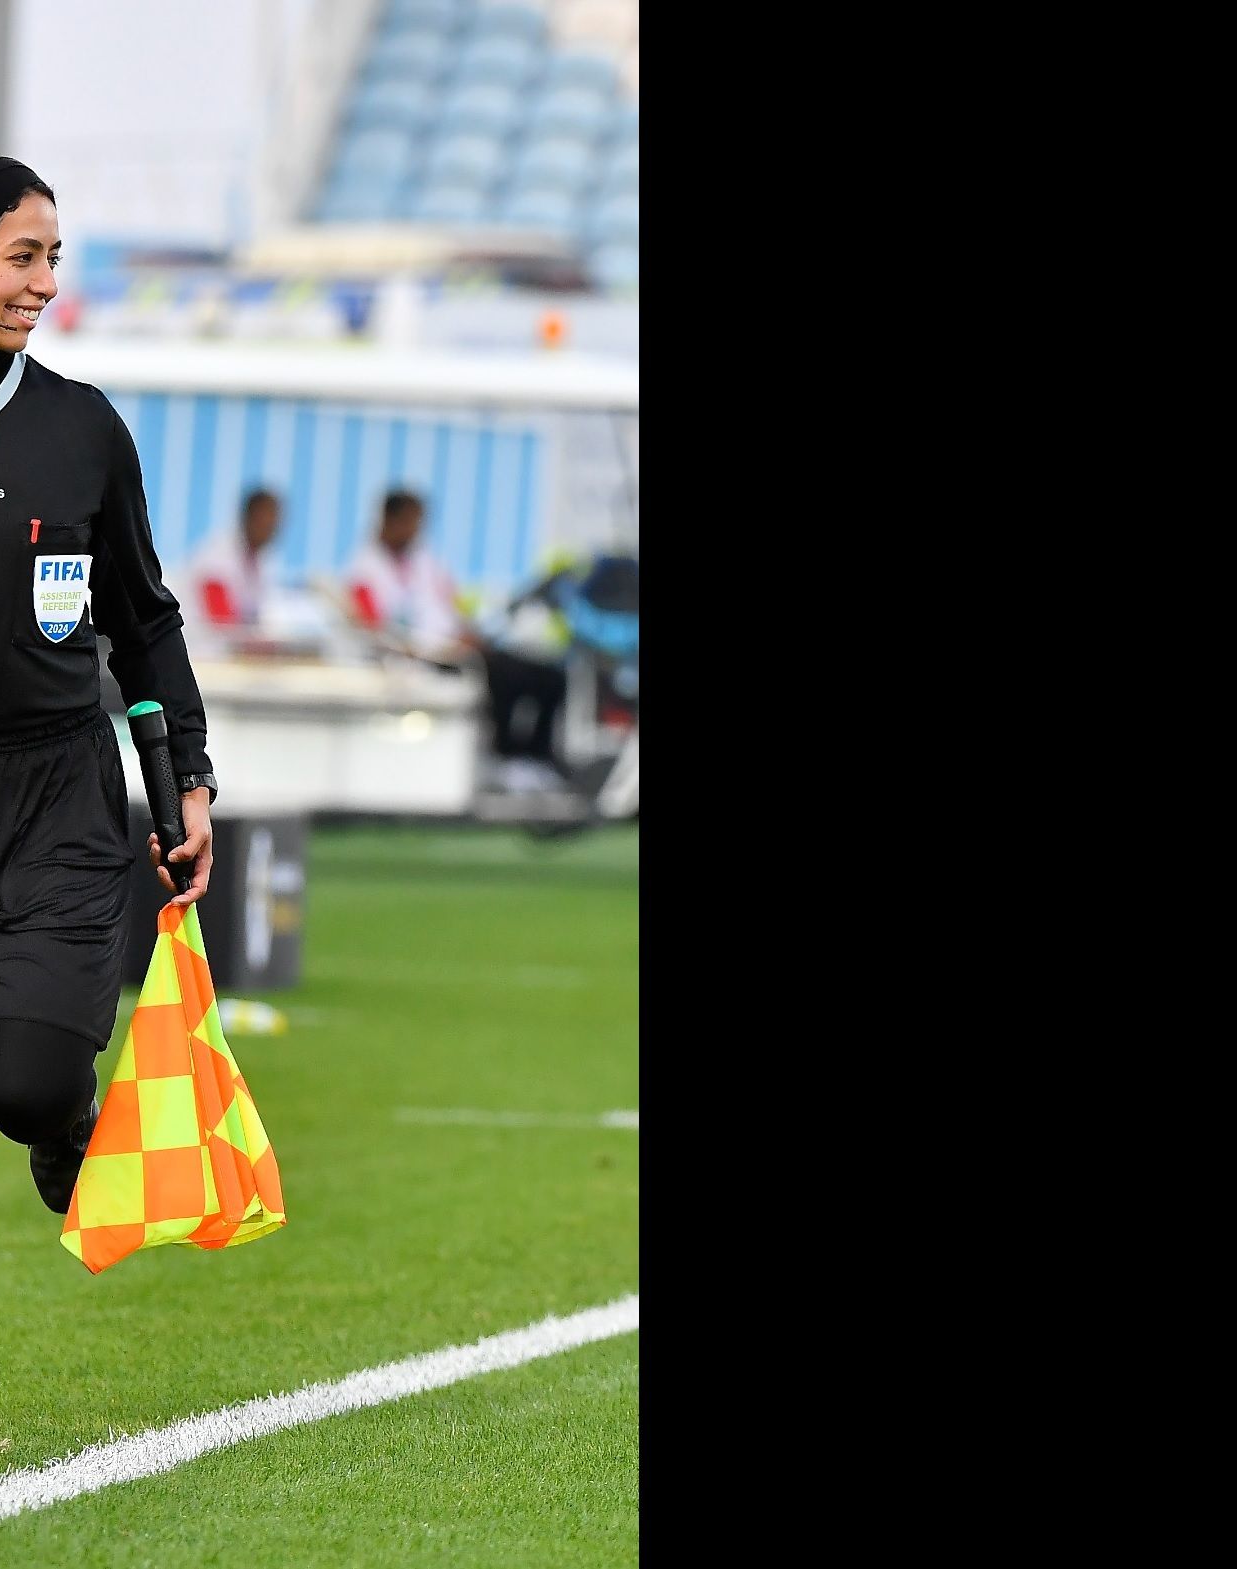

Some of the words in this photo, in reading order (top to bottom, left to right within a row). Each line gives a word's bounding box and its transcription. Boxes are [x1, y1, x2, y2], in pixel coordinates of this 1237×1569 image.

[40, 561, 84, 581] FIFA
[39, 591, 82, 600] ASSISTANT
[42, 601, 78, 611] REFEREE
[47, 623, 68, 634] 2024
